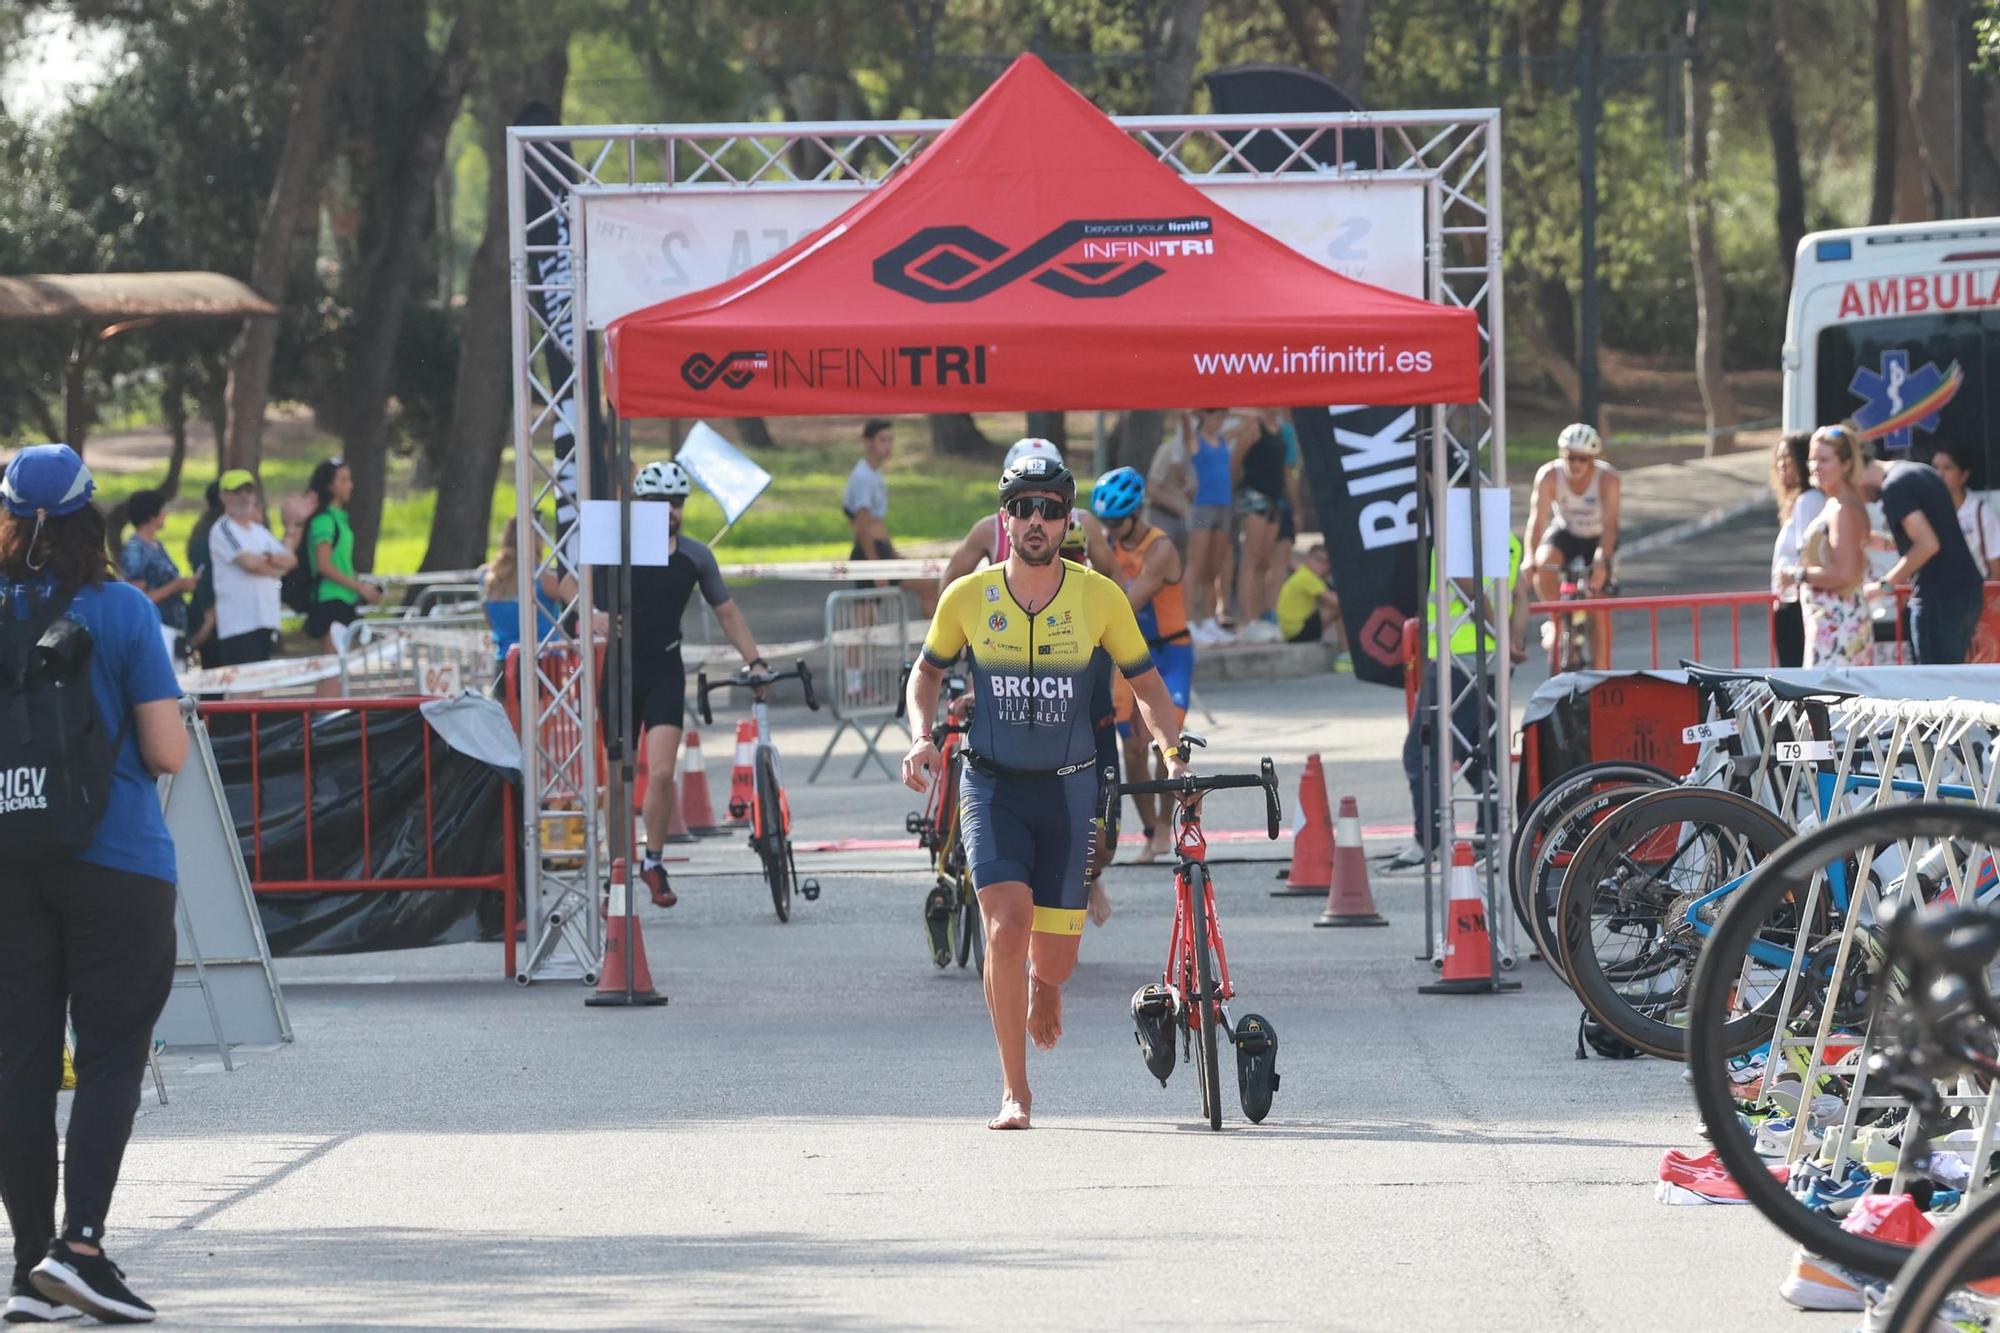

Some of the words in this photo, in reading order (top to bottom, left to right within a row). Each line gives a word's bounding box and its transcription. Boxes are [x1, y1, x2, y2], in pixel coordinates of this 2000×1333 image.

[1084, 224, 1133, 234] beyond
[1137, 224, 1164, 234] your
[1168, 220, 1209, 231] limits
[1084, 239, 1214, 259] INFINITRI
[773, 345, 987, 389] INFINITRI
[1193, 345, 1433, 375] www.infinitri.es
[1329, 405, 1431, 550] BIK
[990, 675, 1074, 699] BROCH
[1599, 688, 1624, 708] 10
[1698, 725, 1712, 738] 96
[1783, 744, 1801, 759] 79
